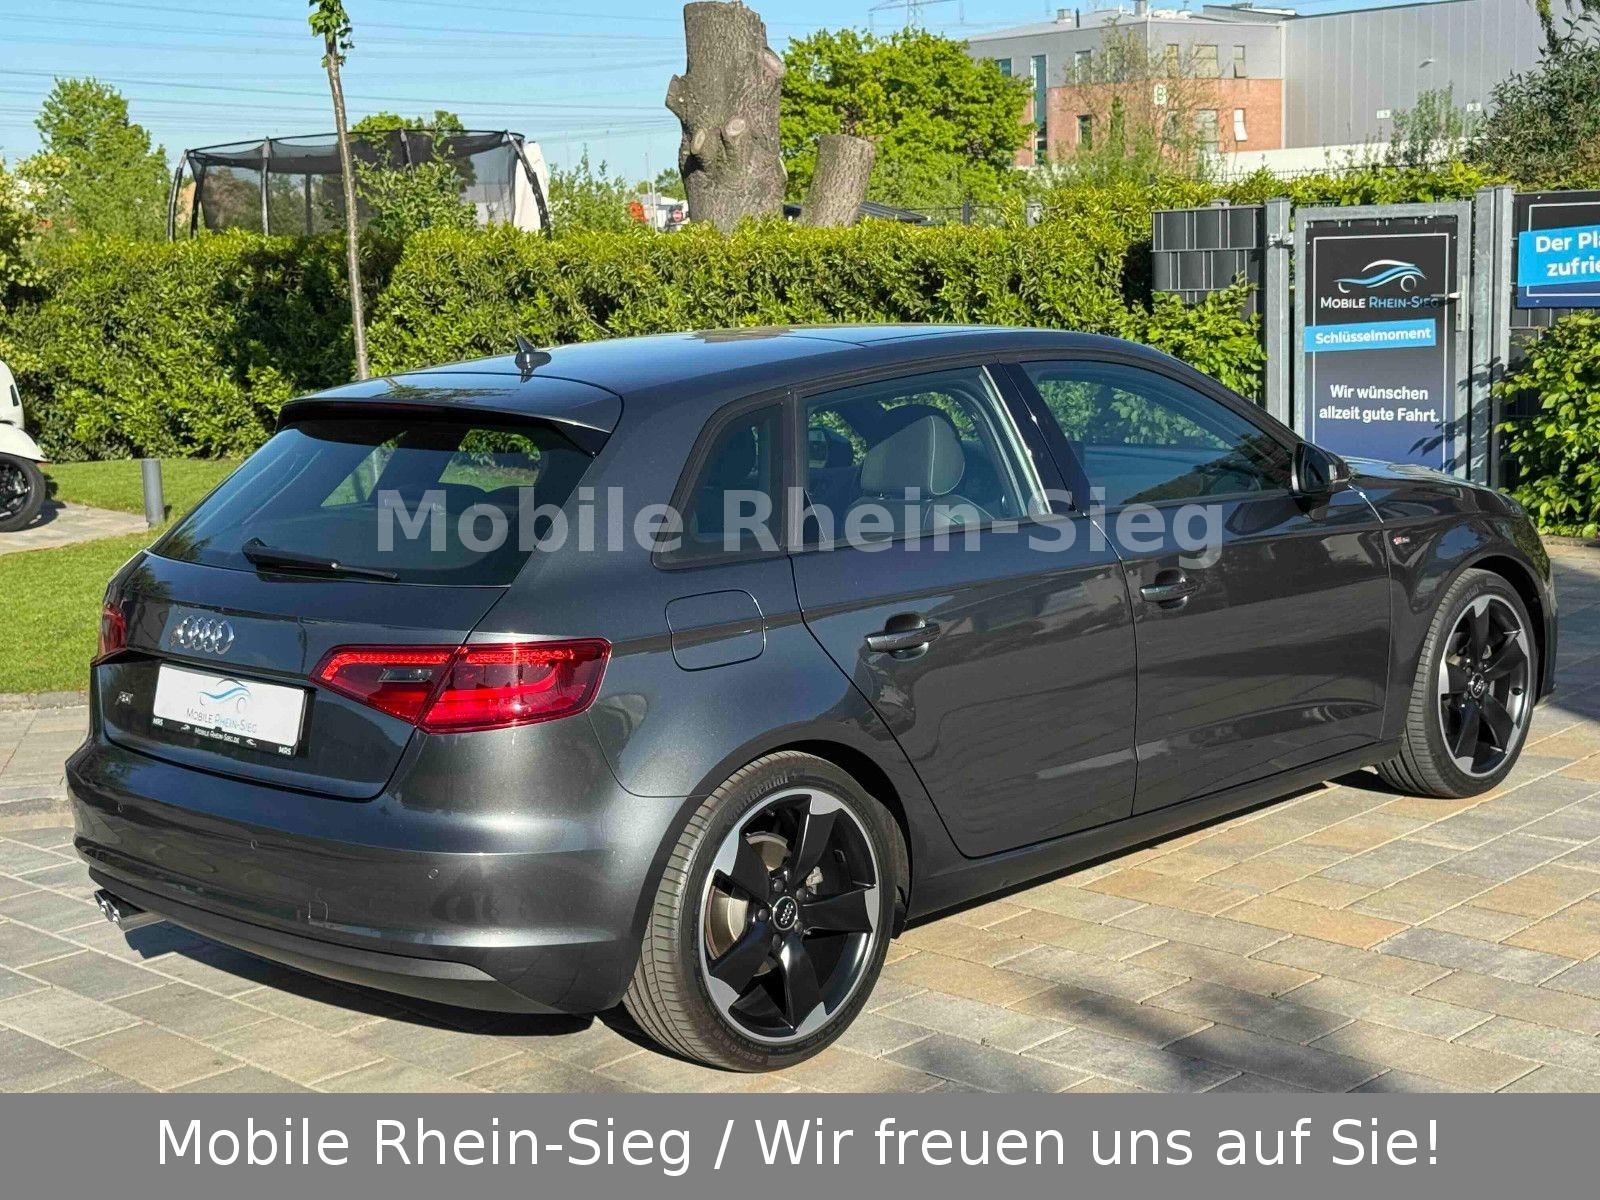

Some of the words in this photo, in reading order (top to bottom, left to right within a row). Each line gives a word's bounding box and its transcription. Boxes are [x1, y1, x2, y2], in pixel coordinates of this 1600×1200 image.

[1535, 235, 1572, 253] Der
[1578, 231, 1600, 250] Pl
[1315, 327, 1432, 345] Schlüsselmoment
[1330, 384, 1355, 399] Wir
[1356, 385, 1429, 401] wünschen
[1319, 408, 1361, 421] allzeit
[1362, 409, 1394, 423] gute
[1397, 408, 1440, 423] Fahrt.
